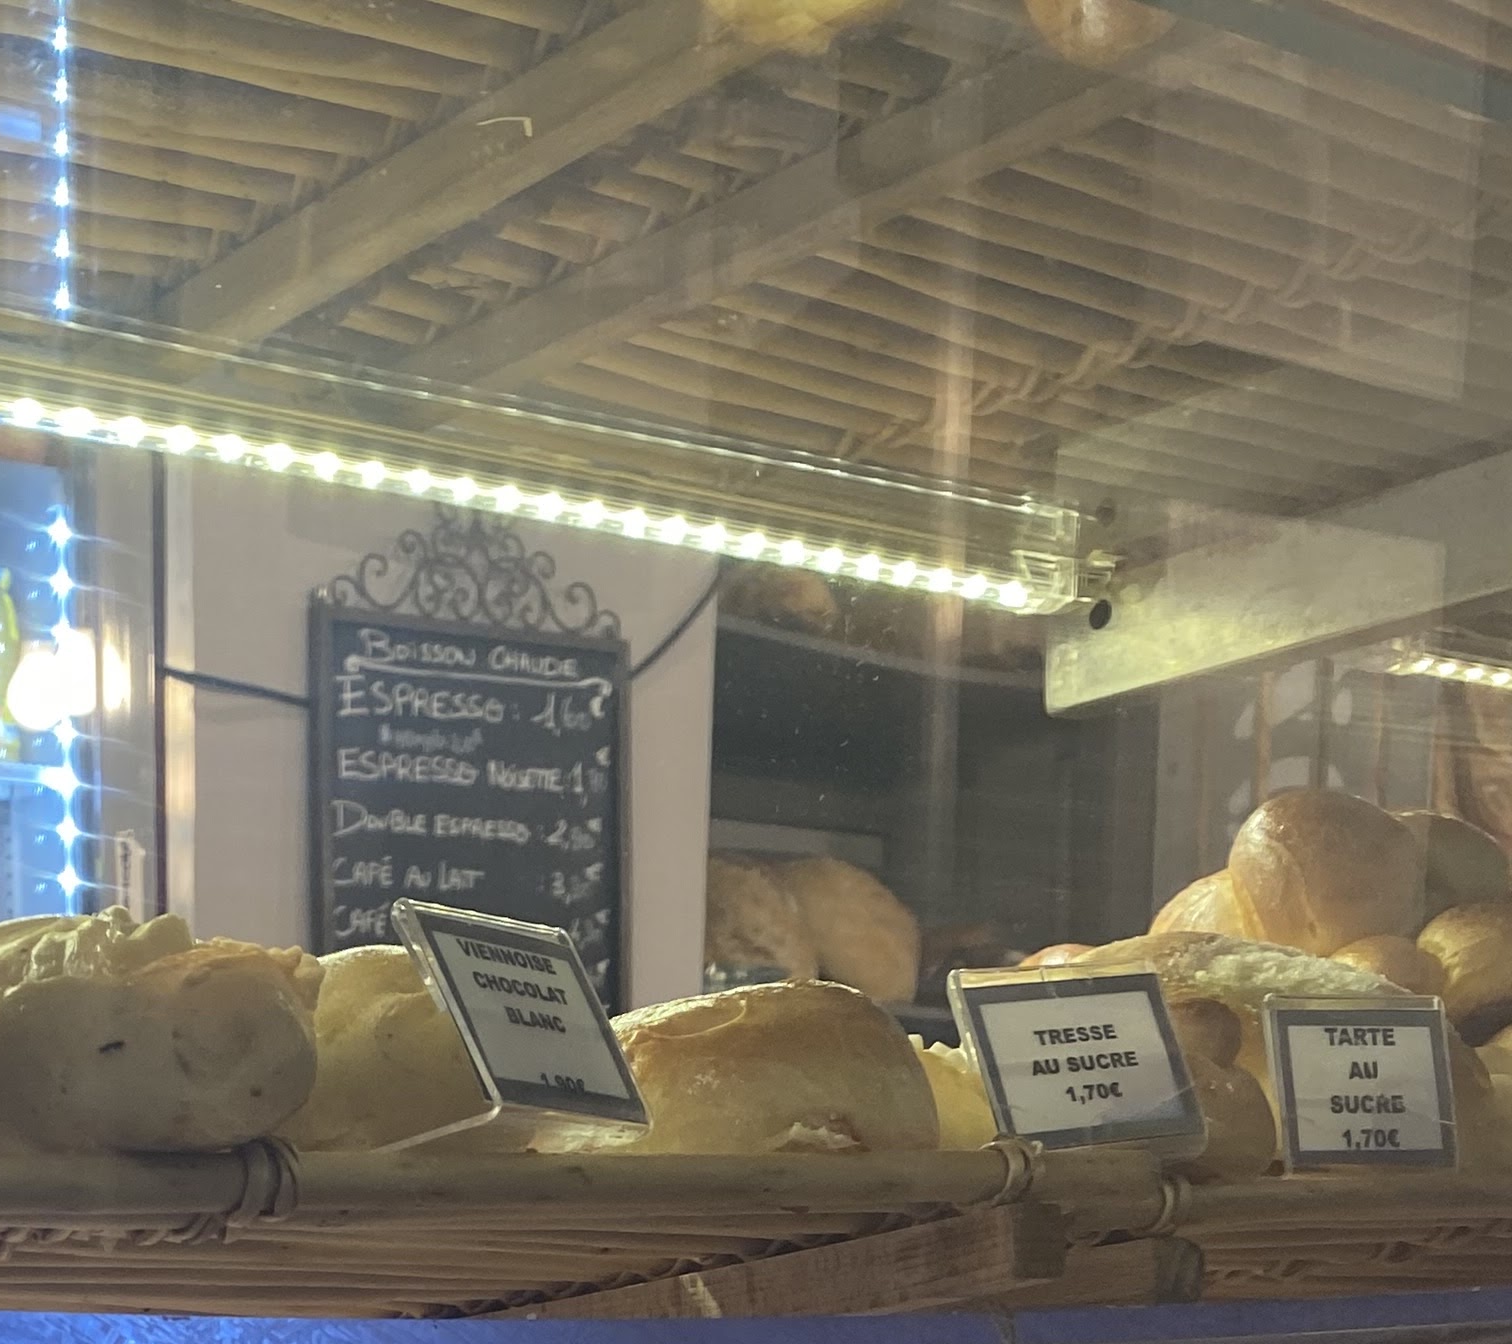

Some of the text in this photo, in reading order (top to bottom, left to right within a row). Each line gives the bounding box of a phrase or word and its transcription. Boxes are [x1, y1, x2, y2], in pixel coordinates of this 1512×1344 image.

[456, 938, 557, 976] VIENNOISE
[472, 971, 569, 1006] CHOCOLAT
[504, 1006, 567, 1034] BLANC
[1034, 1024, 1117, 1047] TRESSE
[1324, 1027, 1396, 1047] TARTE
[1031, 1051, 1140, 1077] AU SUCRE
[1348, 1061, 1379, 1080] AU
[1065, 1082, 1123, 1105] 1,70€
[1329, 1094, 1406, 1116] SUCRE
[1341, 1128, 1401, 1150] 1,70€
